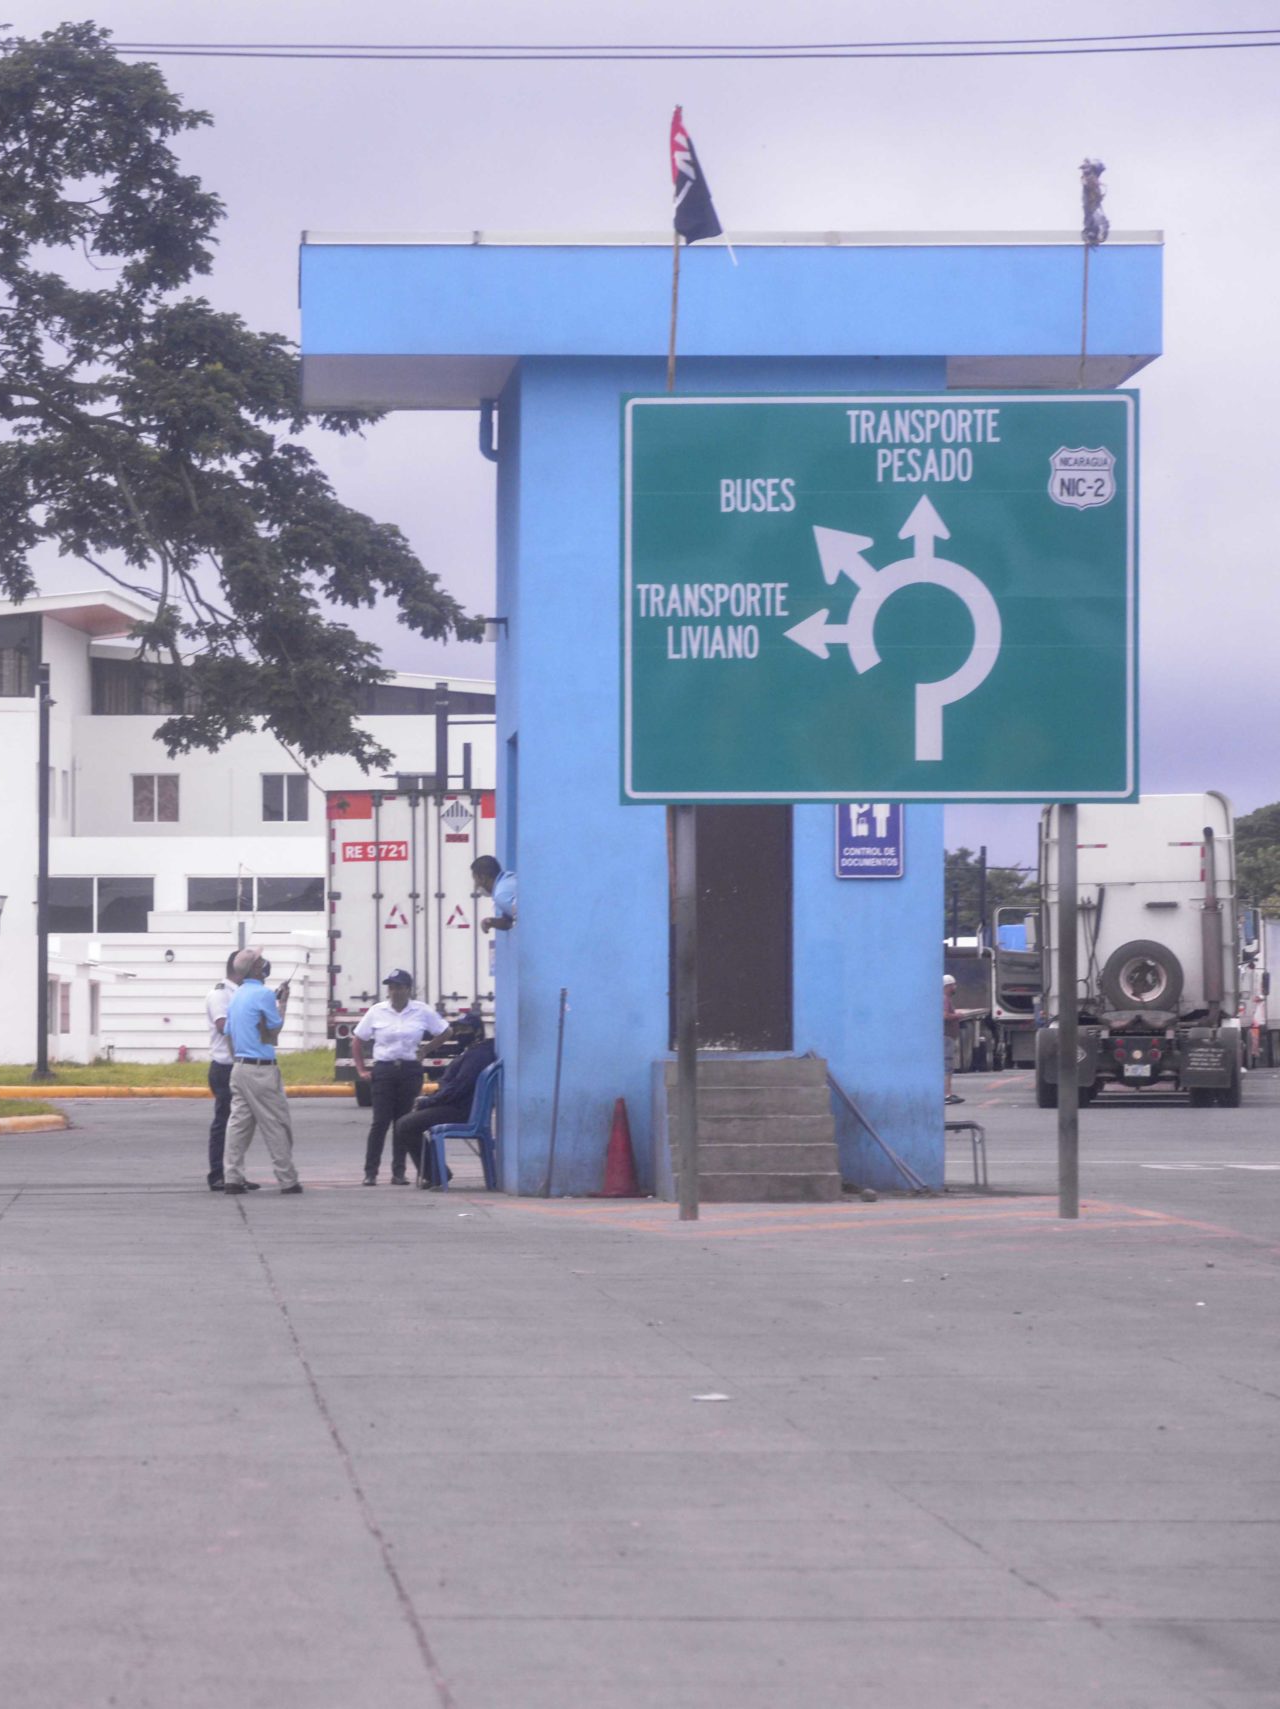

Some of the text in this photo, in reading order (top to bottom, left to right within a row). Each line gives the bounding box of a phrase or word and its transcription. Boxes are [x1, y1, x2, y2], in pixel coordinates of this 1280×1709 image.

[846, 409, 1001, 444] TRANSPORTE
[876, 448, 973, 482] PESADO
[1059, 456, 1109, 467] NICARAGUA
[719, 478, 796, 512] BUSES
[1059, 477, 1106, 497] NIC-2
[636, 582, 790, 618] TRANSPORTE
[666, 625, 759, 660] LIVIANO
[344, 844, 407, 859] RE 9721
[840, 857, 898, 867] DOCUMENTOS
[842, 847, 897, 856] CONTROL DE
